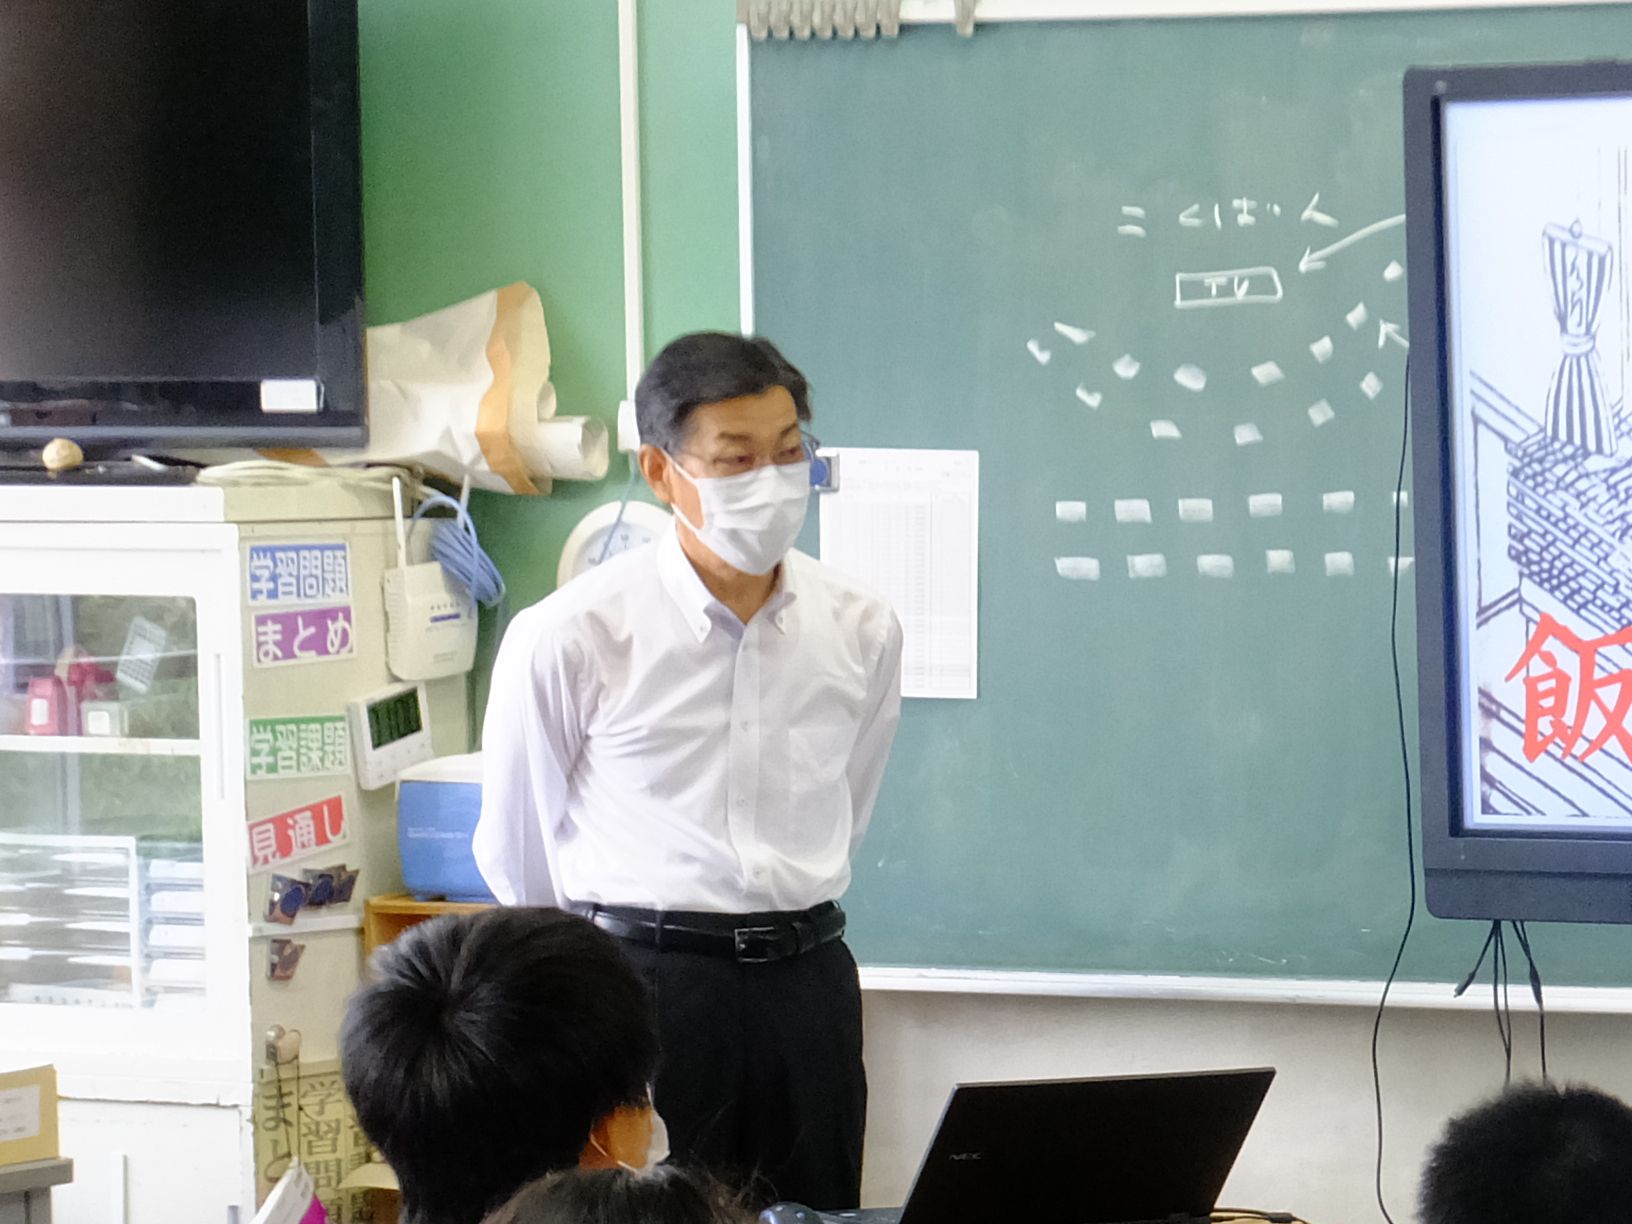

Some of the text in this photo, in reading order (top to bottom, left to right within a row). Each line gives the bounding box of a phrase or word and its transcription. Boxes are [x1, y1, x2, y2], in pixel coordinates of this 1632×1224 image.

[1203, 275, 1250, 301] TV
[251, 549, 348, 602] 学習問題
[257, 613, 352, 662] まとめ
[251, 804, 344, 868] 見通し
